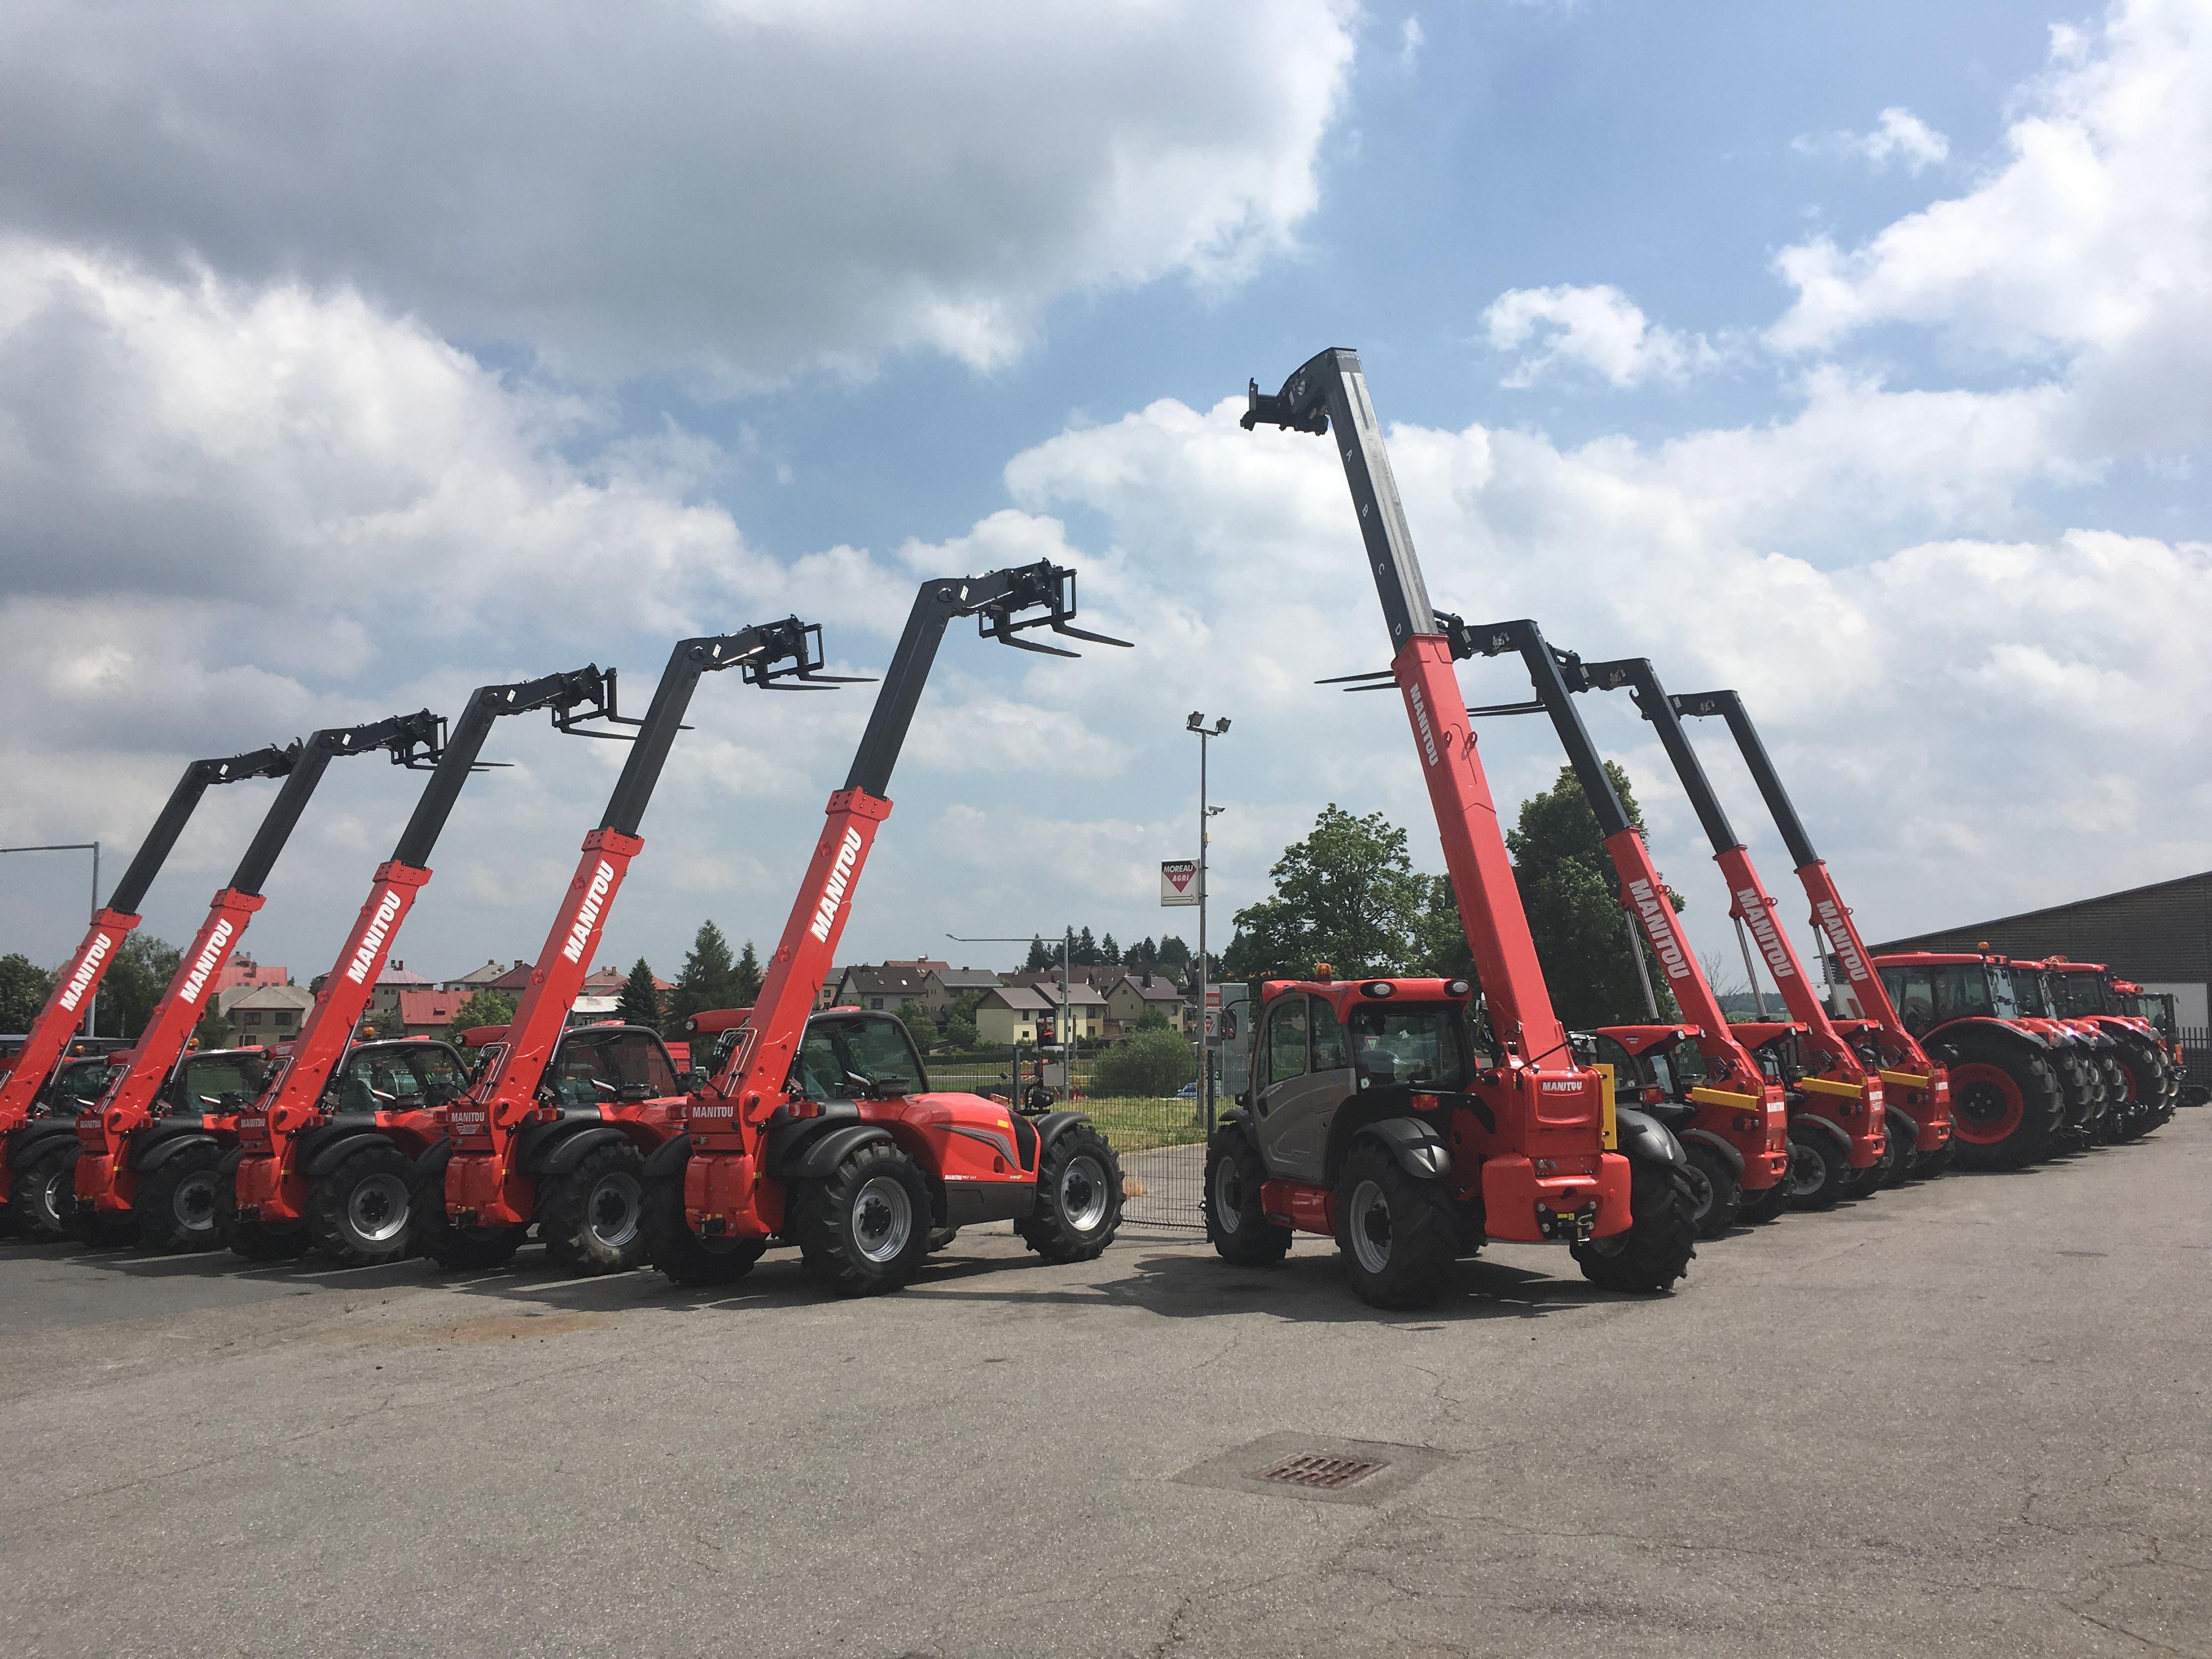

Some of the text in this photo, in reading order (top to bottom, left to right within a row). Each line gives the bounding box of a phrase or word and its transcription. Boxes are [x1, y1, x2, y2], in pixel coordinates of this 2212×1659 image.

[1345, 448, 1353, 462] A
[1361, 503, 1369, 518] B
[1378, 562, 1385, 576] C
[1394, 622, 1402, 637] D
[1410, 682, 1439, 767] MANITOU
[1164, 865, 1193, 873] MOREAU
[810, 826, 863, 944] MANITOU
[562, 859, 615, 965] MANITOU
[1627, 878, 1691, 980] MANITOU
[1736, 886, 1796, 978] MANITOU
[346, 889, 402, 985] MANITOU
[1815, 899, 1869, 982] MANITOU
[179, 918, 233, 1004] MANITOU
[59, 932, 112, 1012] MANITOU
[1542, 1081, 1582, 1092] MANITOU
[451, 1112, 484, 1122] MANITOU
[692, 1106, 734, 1118] MANITOU
[80, 1119, 101, 1128] MANITOU
[241, 1118, 265, 1128] MANITOU
